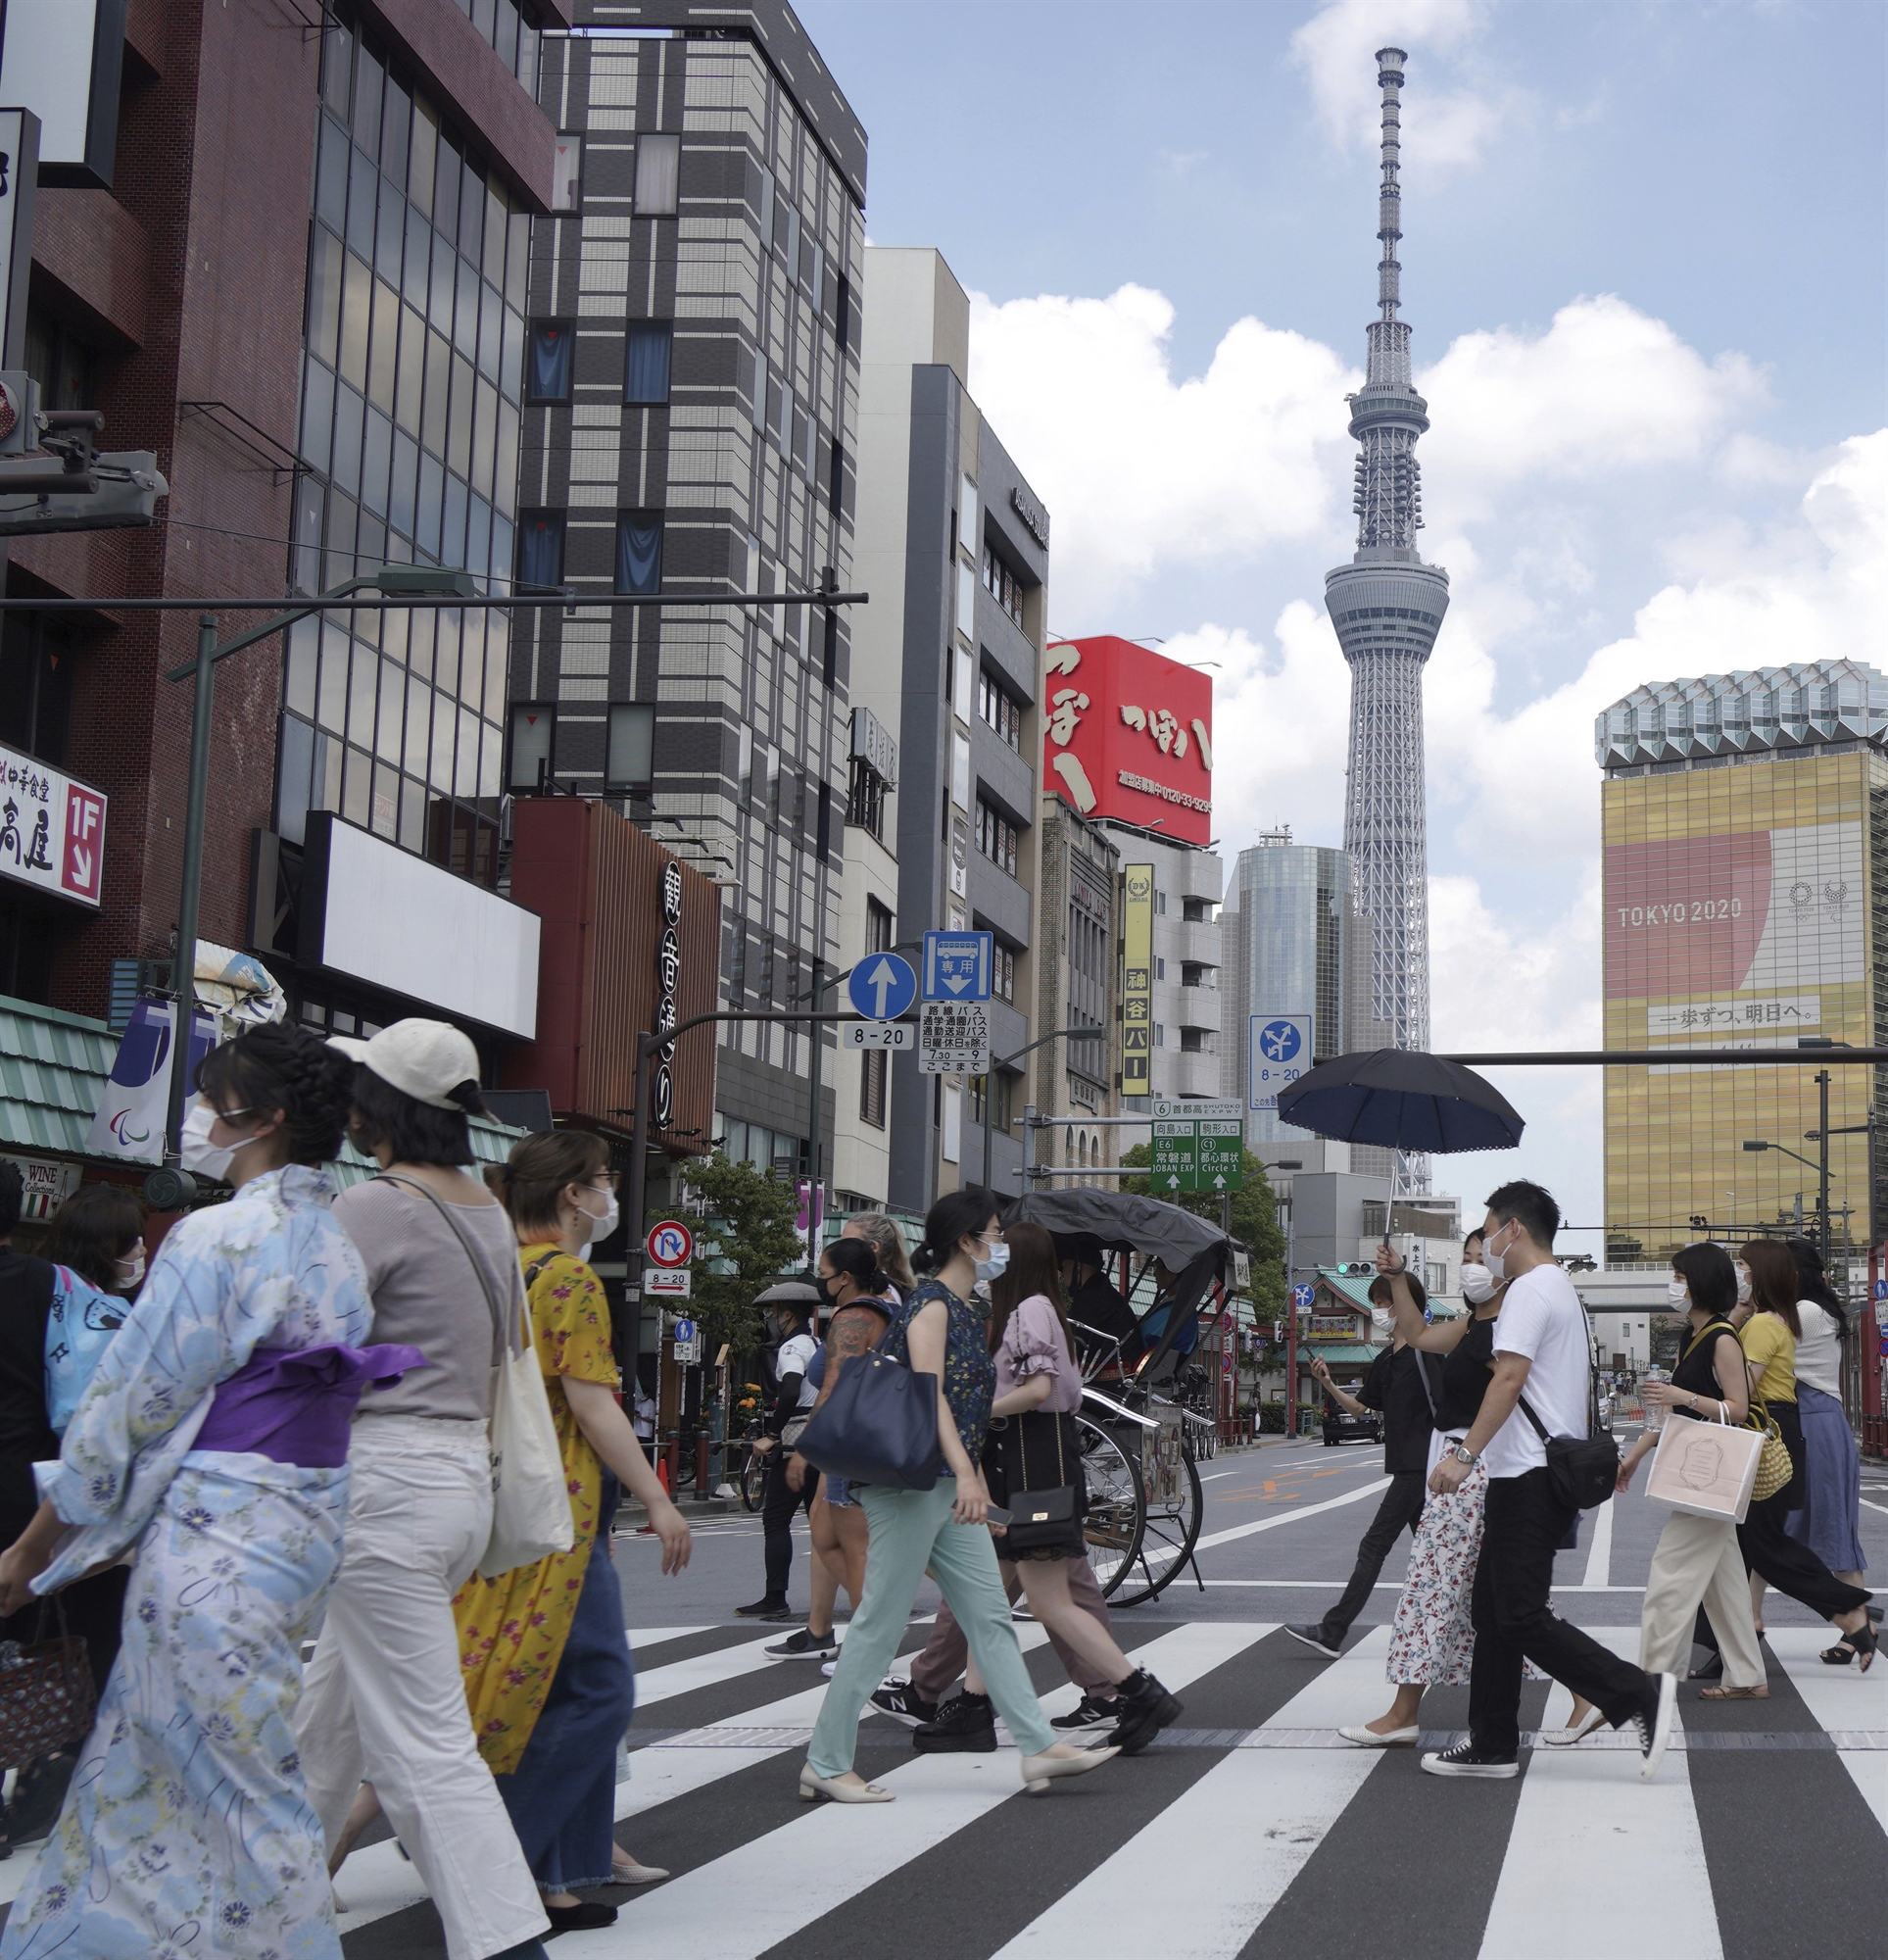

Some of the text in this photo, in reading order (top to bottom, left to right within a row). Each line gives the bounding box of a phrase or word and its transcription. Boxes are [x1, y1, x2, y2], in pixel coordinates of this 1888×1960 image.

[1119, 705, 1214, 771] つぼ八
[72, 796, 99, 841] 1F
[1618, 898, 1742, 927] TOKYO 2020
[941, 960, 974, 974] 専用
[928, 1005, 983, 1015] 路線バス
[1660, 1003, 1812, 1029] 一歩ずつ、明日へ。
[1127, 971, 1147, 1077] 神谷バー
[922, 1026, 987, 1036] 通勤送迎バス
[927, 1061, 980, 1072] ここまで
[1159, 1103, 1202, 1114] 6 首都高
[1156, 1123, 1191, 1135] 向島入口
[1202, 1123, 1237, 1135] 駒形入口
[1158, 1140, 1171, 1149] E6
[1203, 1140, 1213, 1150] C1
[1200, 1152, 1239, 1163] 都心環状
[1152, 1164, 1178, 1174] JOBAN
[1201, 1163, 1237, 1172] Circle 1
[28, 1164, 58, 1184] WINE
[24, 1182, 56, 1195] Collections
[1412, 1244, 1421, 1277] 水上バ
